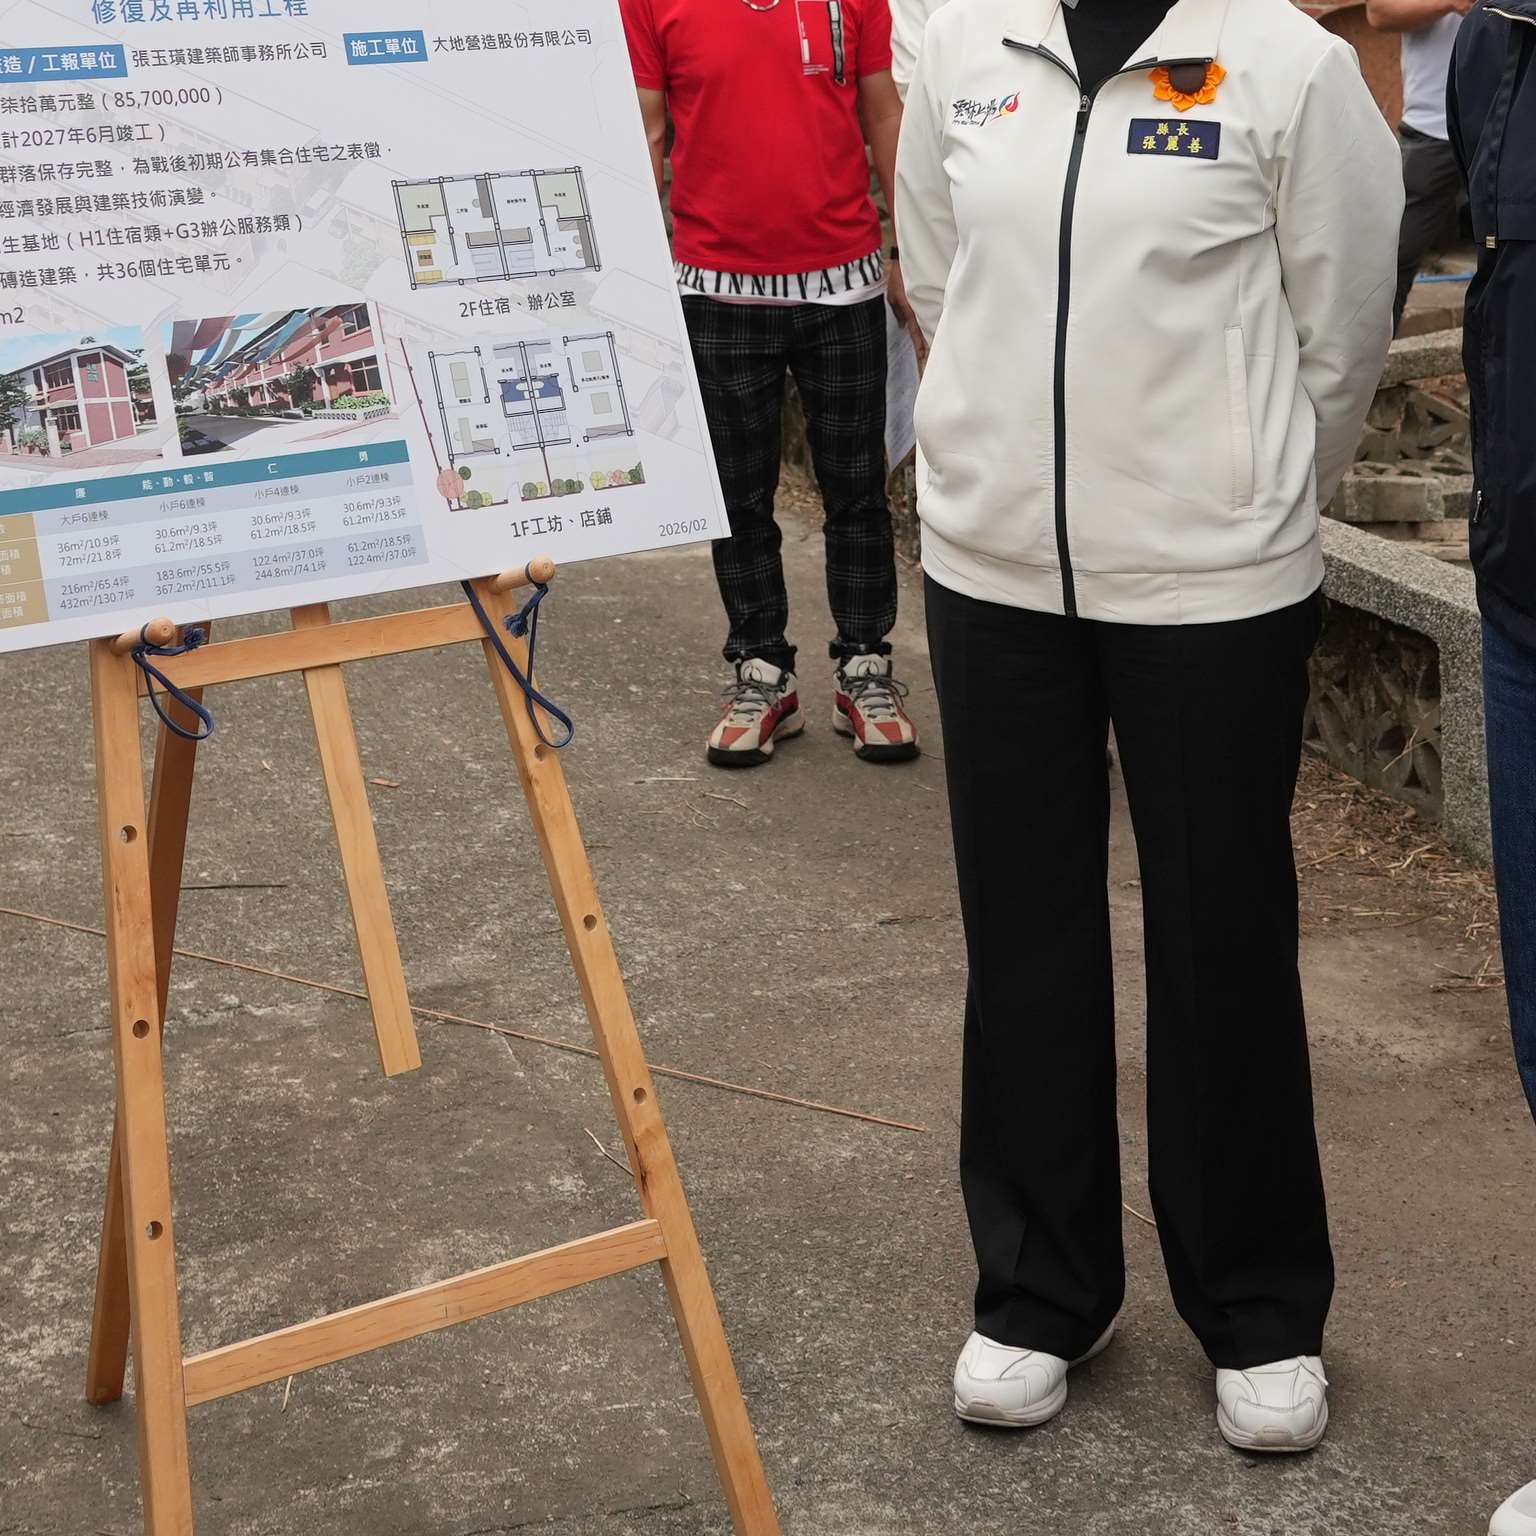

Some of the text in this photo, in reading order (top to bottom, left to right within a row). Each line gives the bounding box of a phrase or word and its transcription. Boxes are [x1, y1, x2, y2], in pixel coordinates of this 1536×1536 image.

[350, 36, 419, 58] 施工單位
[433, 29, 592, 53] 大地營造股份有限公司
[1156, 122, 1190, 136] 縣長
[1142, 135, 1203, 153] 張麗善
[459, 291, 577, 318] 2F住宿、辦公室
[659, 518, 708, 537] 2026/02
